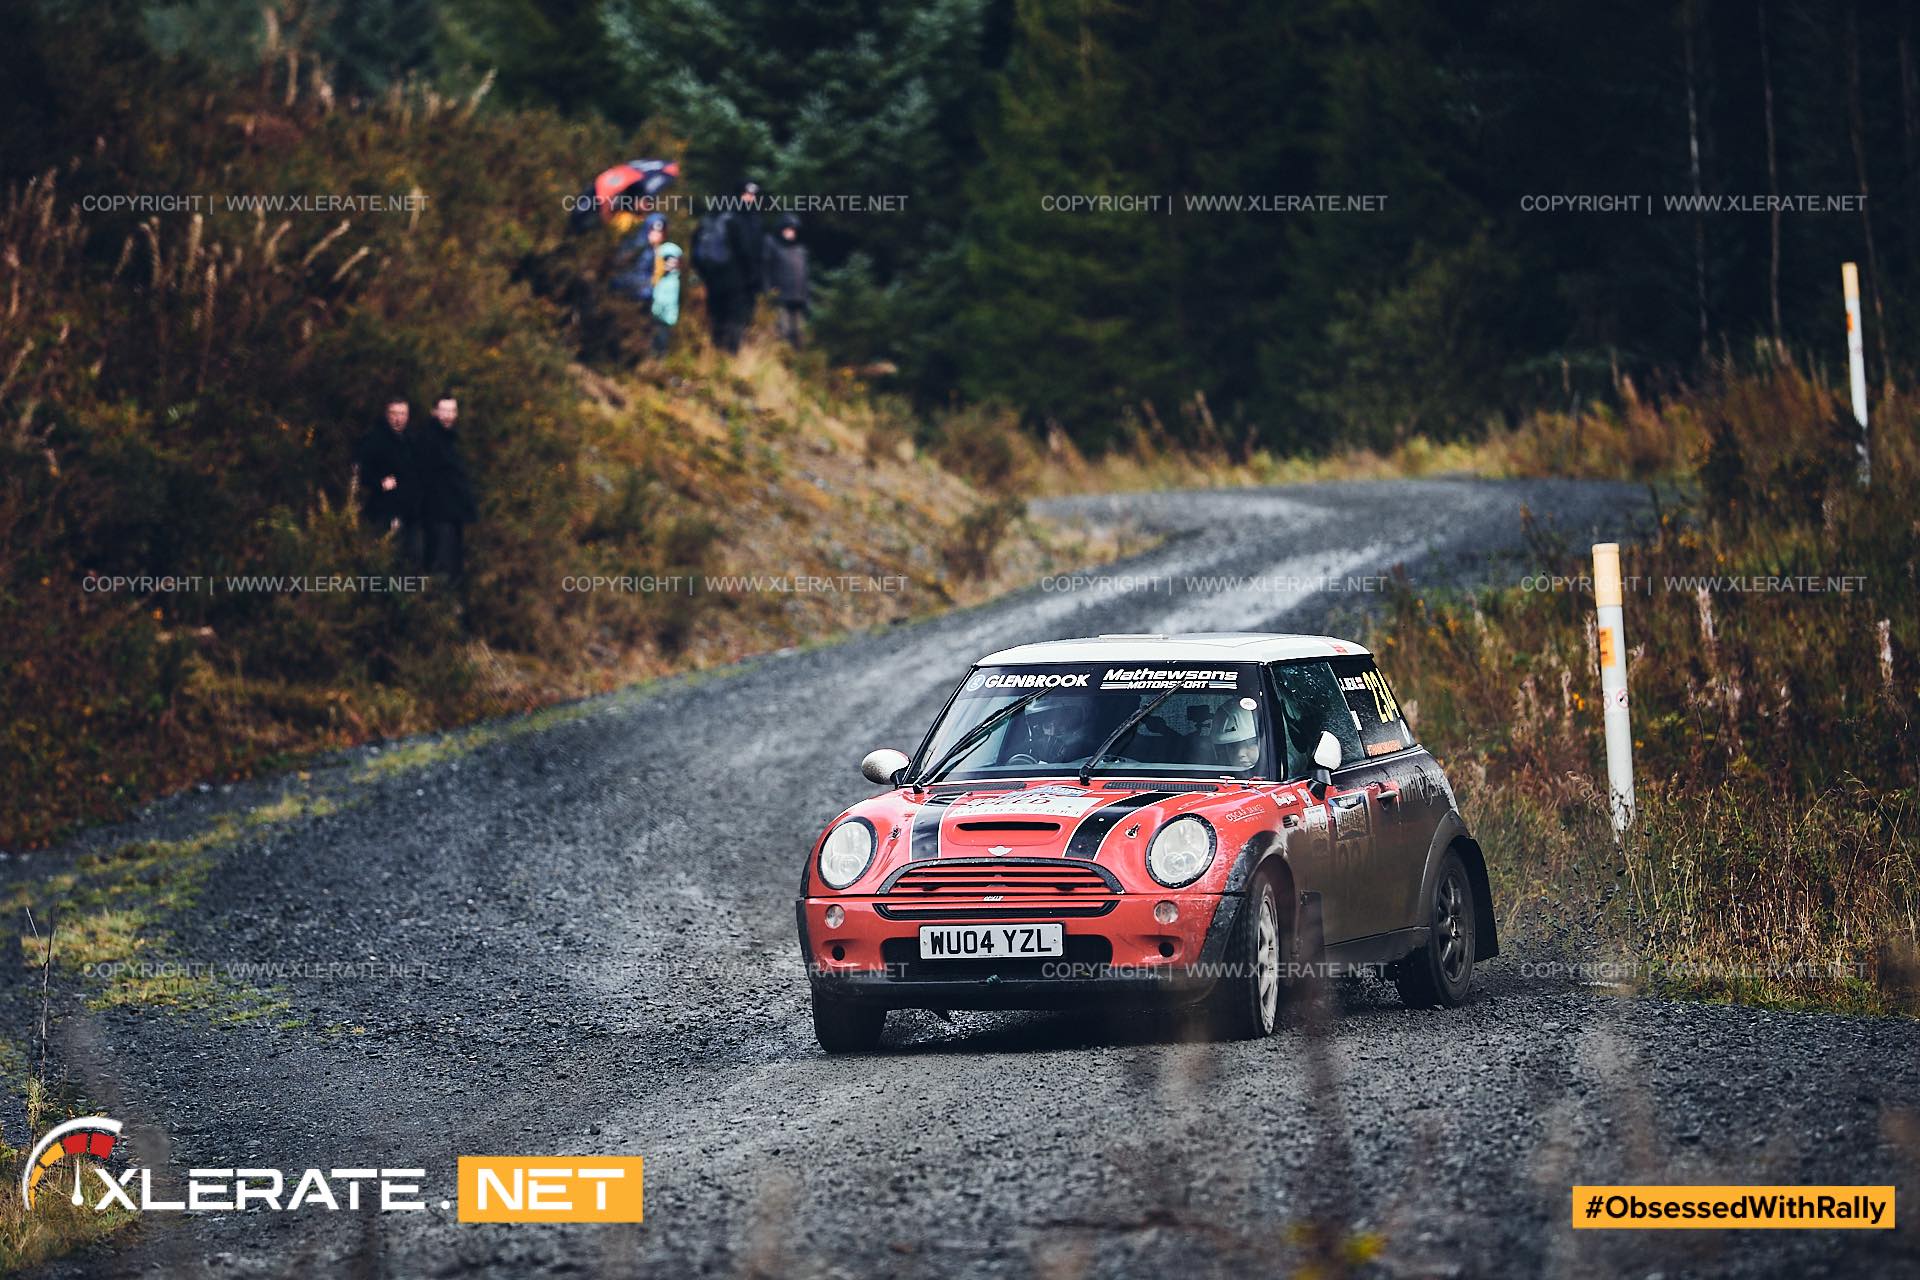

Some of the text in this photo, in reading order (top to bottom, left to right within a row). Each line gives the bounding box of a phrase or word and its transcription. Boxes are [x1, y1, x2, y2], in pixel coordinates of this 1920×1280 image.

[984, 673, 1091, 689] GLENBROOK
[1102, 668, 1239, 681] Mathewsons
[930, 928, 1052, 955] WU04 YZL
